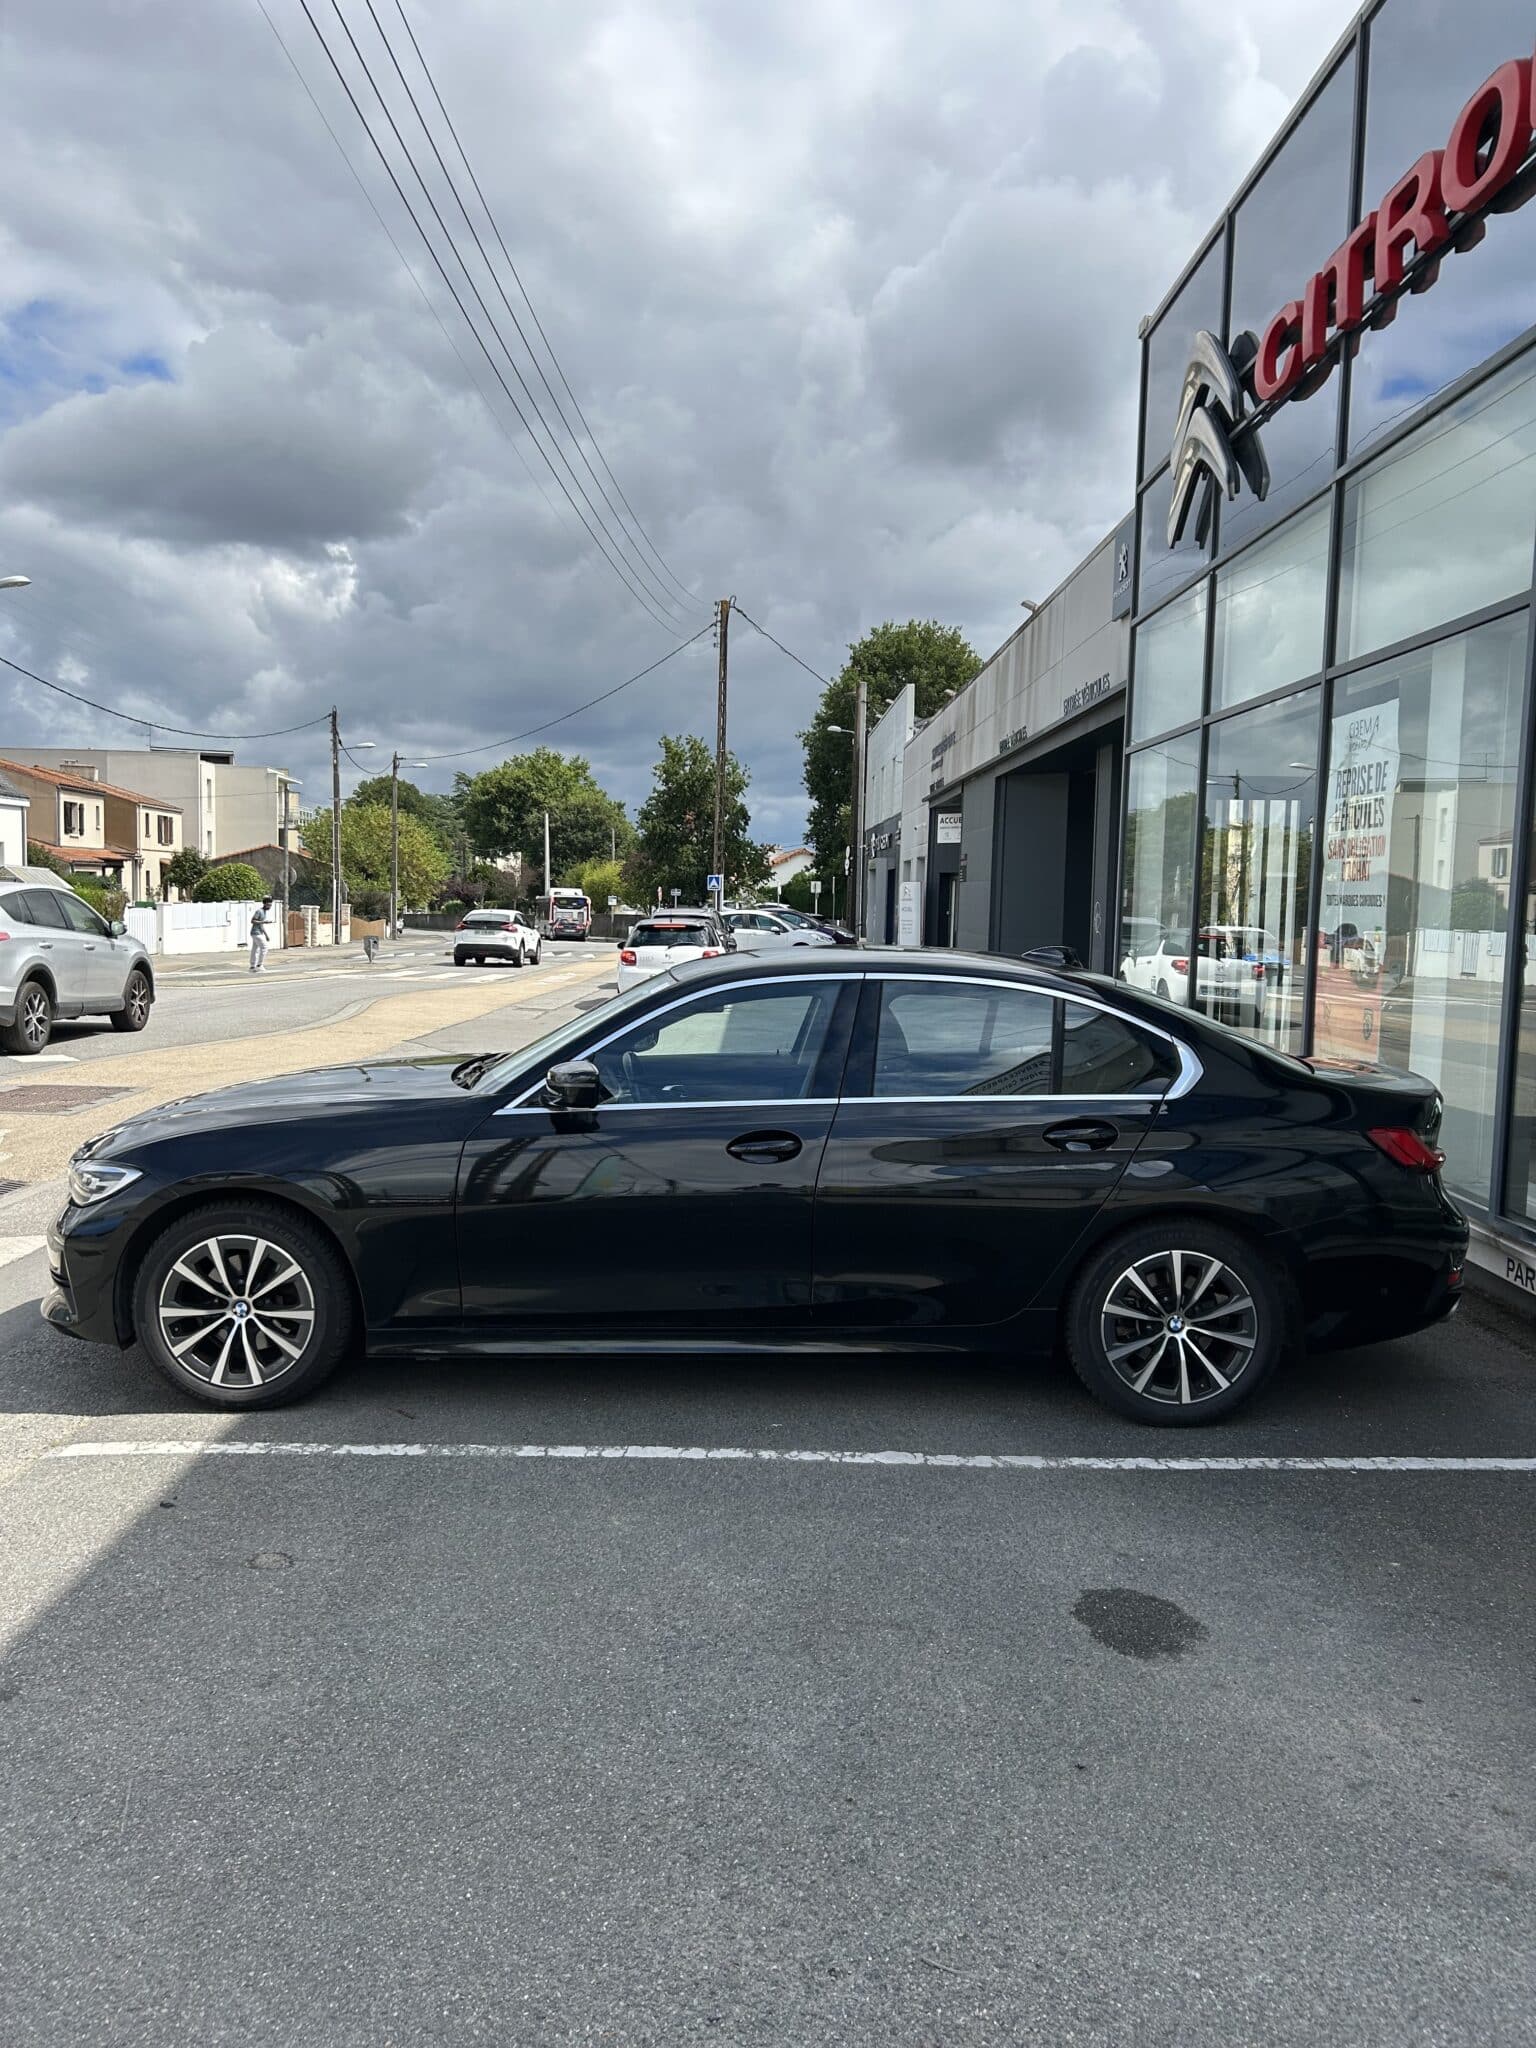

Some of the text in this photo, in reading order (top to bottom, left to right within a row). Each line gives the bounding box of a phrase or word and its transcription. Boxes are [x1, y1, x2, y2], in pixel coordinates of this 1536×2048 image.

[1255, 32, 1536, 401] CITRO
[1336, 760, 1389, 800] REPRISE DE
[1328, 838, 1346, 860] SANS
[1507, 1257, 1535, 1291] PAR
